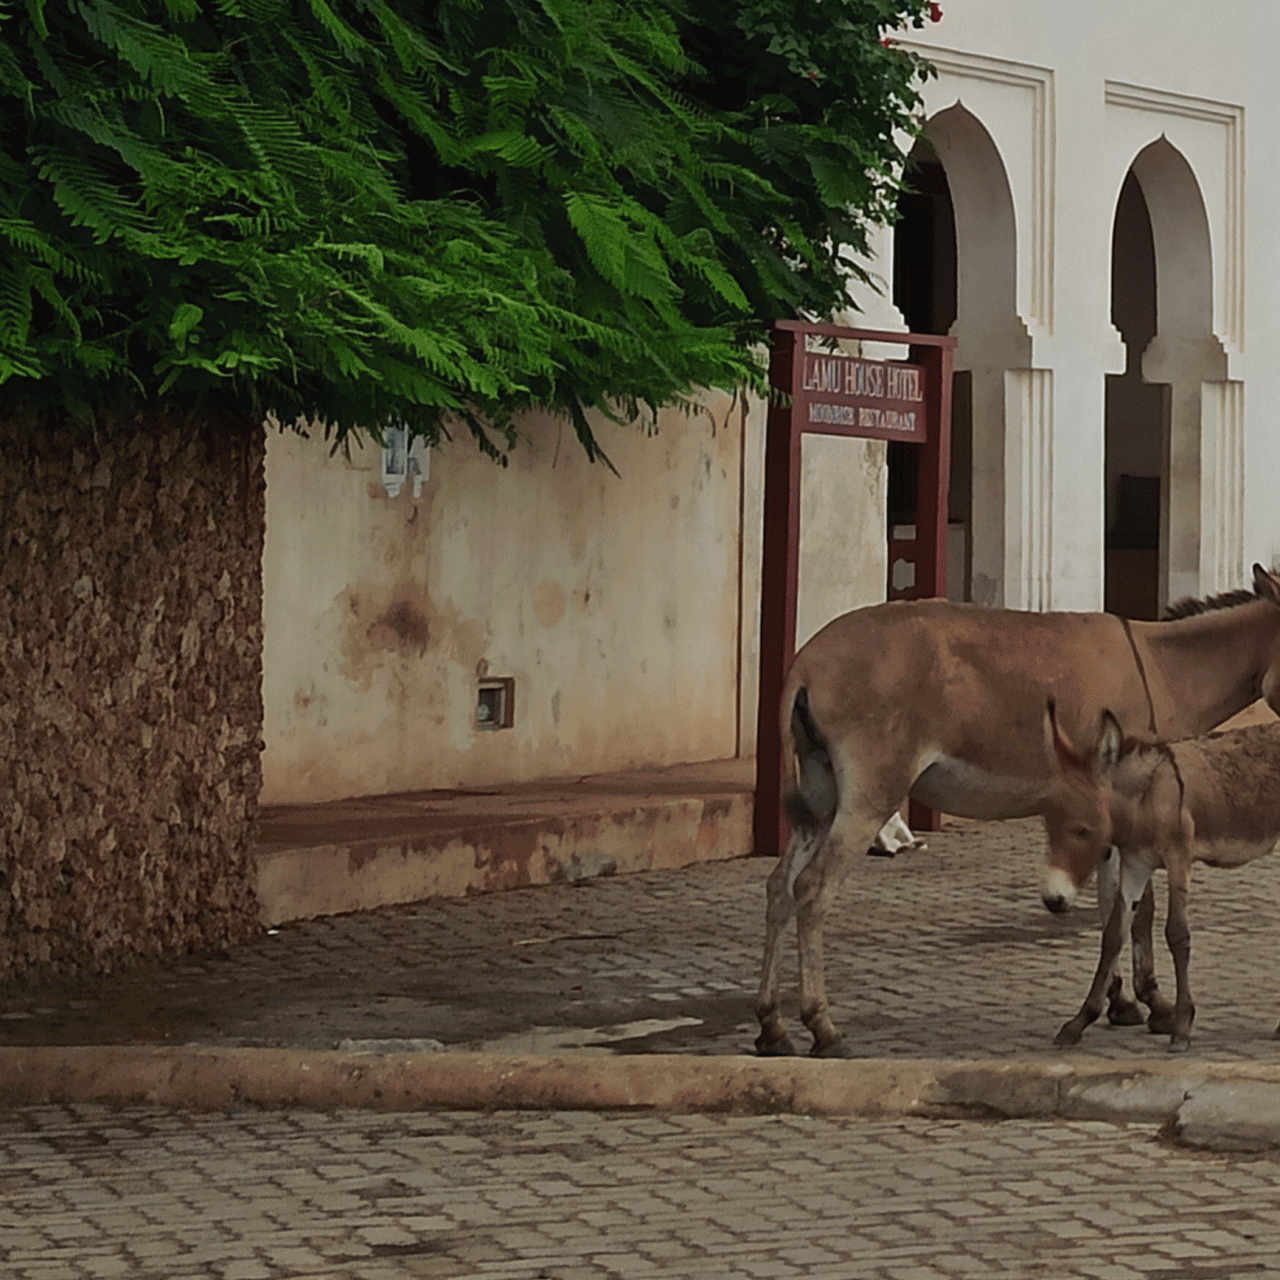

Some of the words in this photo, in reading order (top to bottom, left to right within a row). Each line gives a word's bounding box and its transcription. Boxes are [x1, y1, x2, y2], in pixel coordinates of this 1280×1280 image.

[802, 356, 841, 394] LAMU
[845, 361, 885, 398] HOUSE
[887, 365, 924, 402] HOTEL
[859, 407, 916, 432] RESTAURANT
